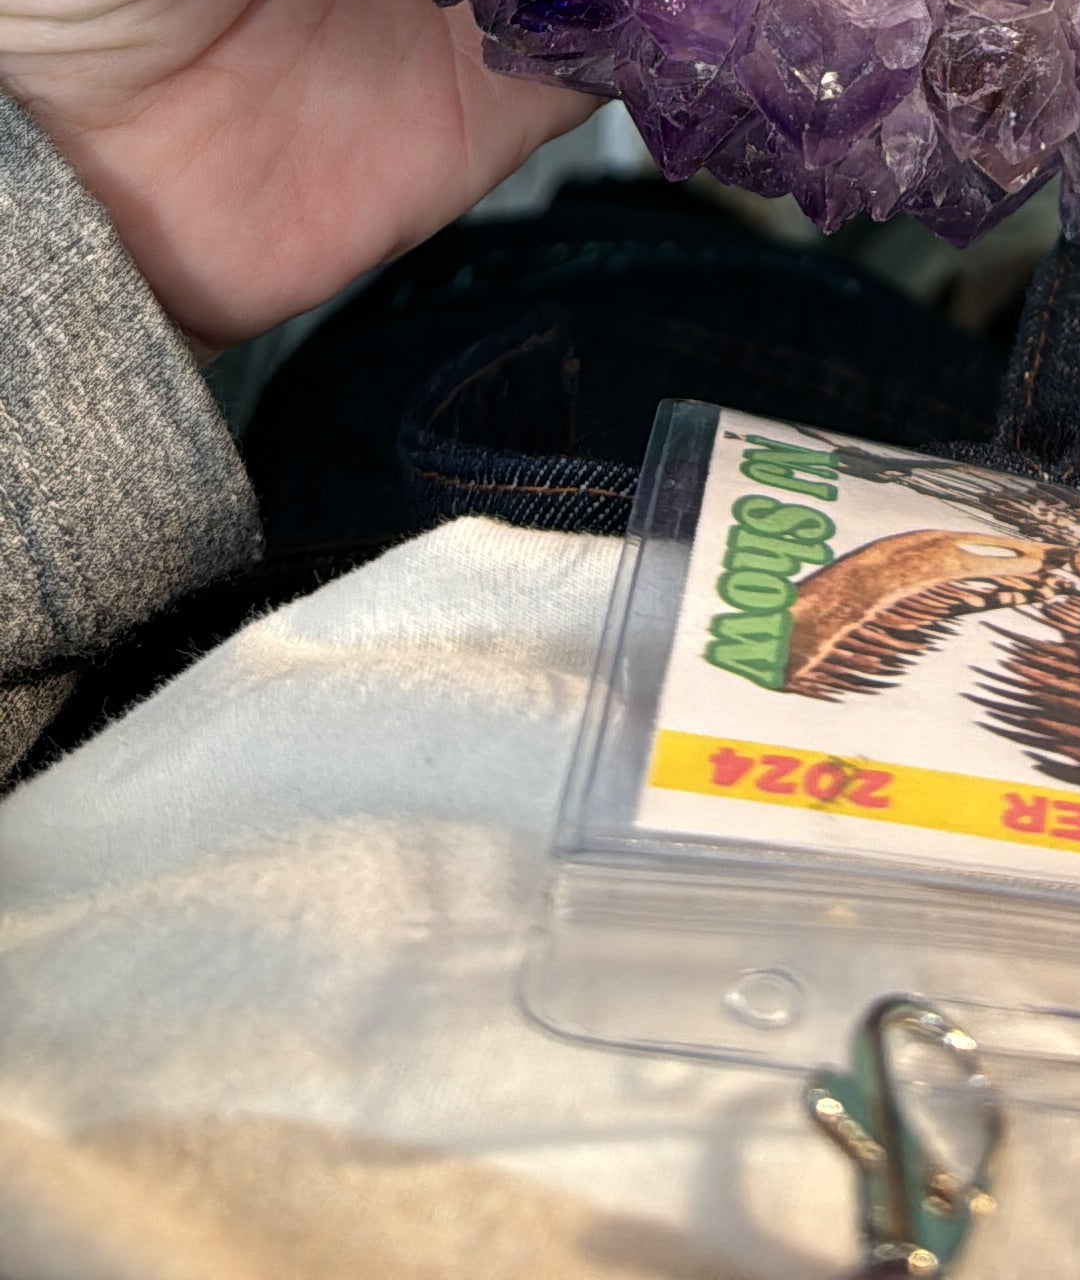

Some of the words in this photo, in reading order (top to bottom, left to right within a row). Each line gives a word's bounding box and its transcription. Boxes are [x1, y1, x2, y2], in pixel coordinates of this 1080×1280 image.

[739, 434, 839, 502] NJ
[702, 494, 836, 691] Show
[708, 746, 894, 810] 2024
